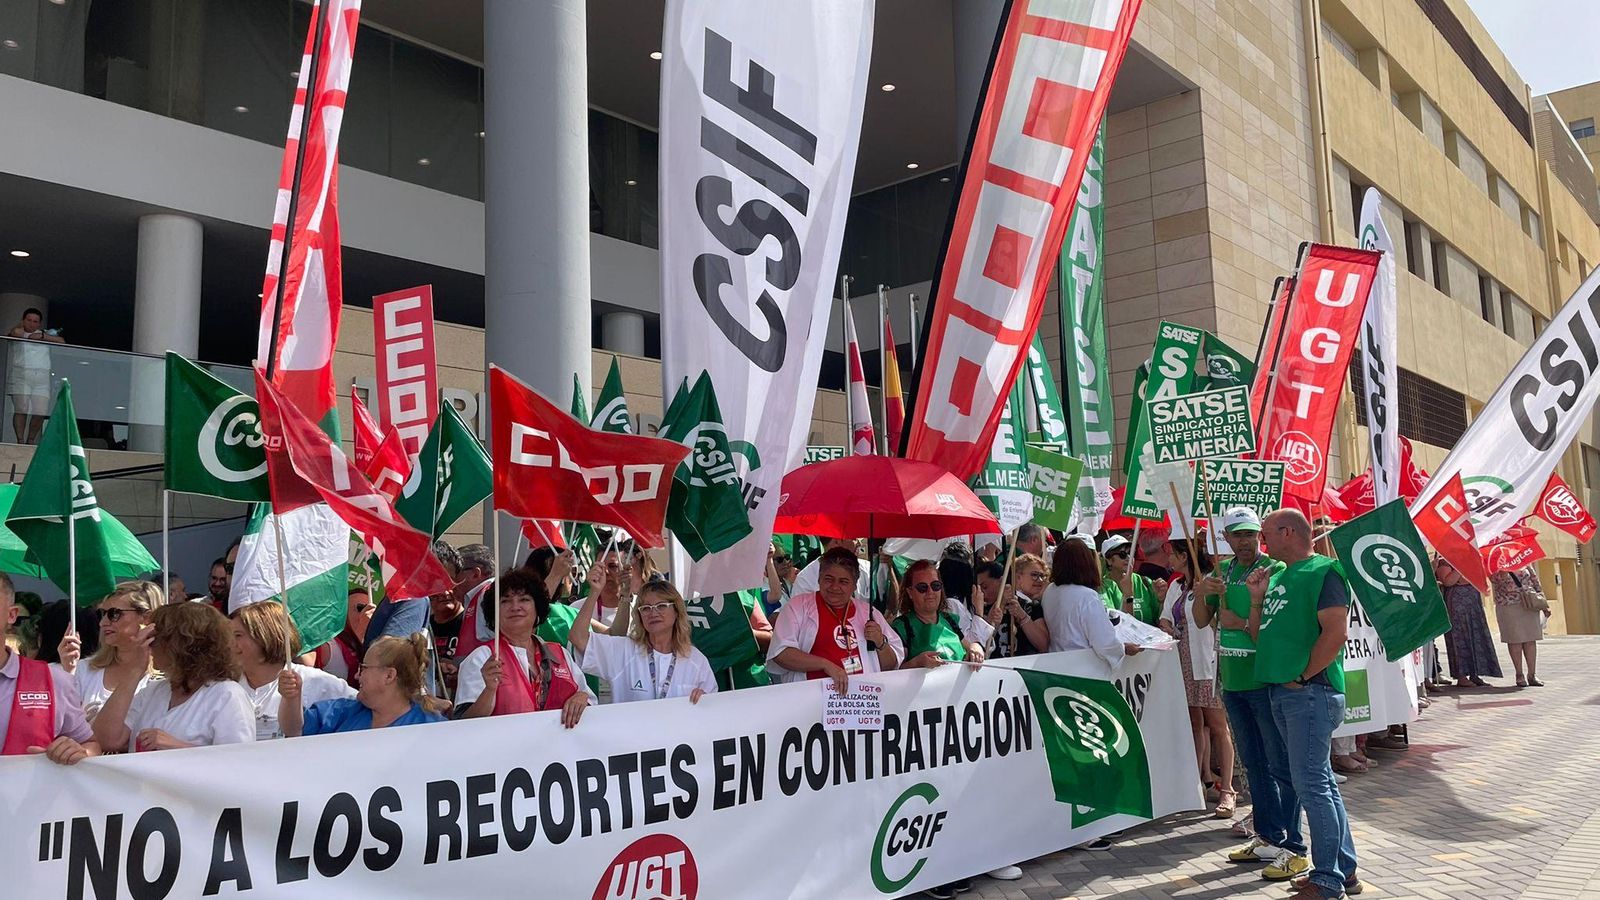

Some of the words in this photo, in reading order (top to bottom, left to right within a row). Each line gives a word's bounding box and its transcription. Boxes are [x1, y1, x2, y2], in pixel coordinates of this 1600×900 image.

[693, 27, 818, 373] CSIF
[1161, 326, 1200, 346] SATSE
[1291, 269, 1360, 419] UGT
[1152, 389, 1246, 423] SATSE
[223, 411, 263, 448] CS
[1154, 416, 1224, 435] SINDICATO
[1227, 412, 1247, 424] DE
[1156, 423, 1248, 445] ENFERMERIA
[694, 436, 741, 486] CSIF
[1159, 434, 1251, 462] ALMERÍA
[1281, 439, 1316, 459] UGT
[1028, 462, 1072, 498] TSE
[1199, 461, 1282, 483] SATSE
[1197, 482, 1260, 493] SNDICATO
[1263, 484, 1279, 494] DE
[1553, 487, 1583, 516] UGT
[1124, 504, 1162, 519] ALMERÍA
[1372, 549, 1417, 604] CSIF
[829, 693, 878, 701] ACTUALIZACIÓN
[826, 717, 839, 725] UGT
[858, 717, 874, 725] UGT
[1345, 705, 1370, 720] SATSE
[1069, 700, 1111, 766] CSIF
[202, 807, 252, 896] A
[276, 786, 404, 885] LOS
[423, 743, 699, 865] RECORTES
[713, 733, 766, 811] EN
[777, 680, 1034, 797] CONTRATACIÓN
[887, 811, 948, 858] CSIF
[606, 850, 687, 900] UGT
